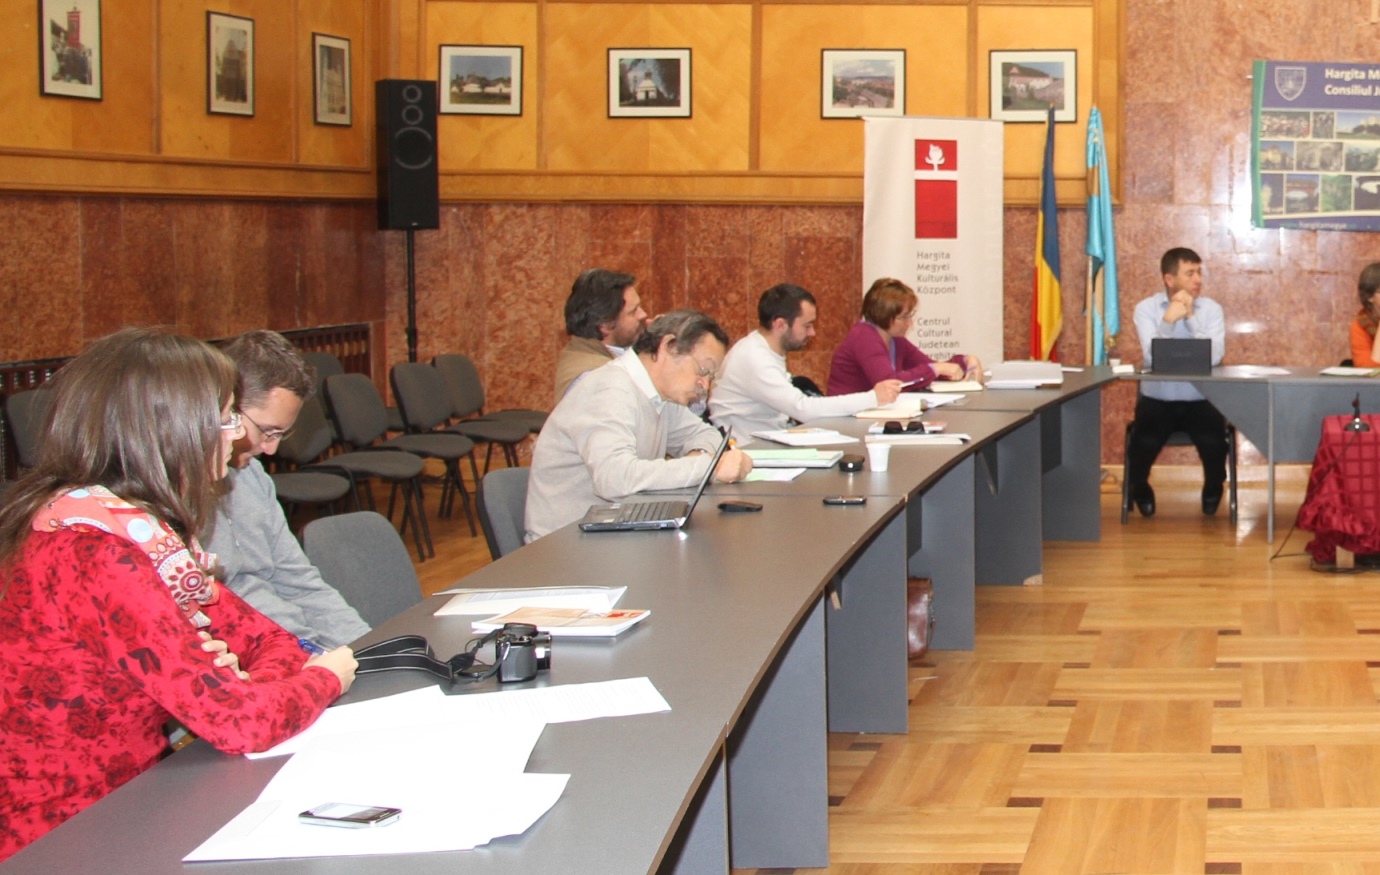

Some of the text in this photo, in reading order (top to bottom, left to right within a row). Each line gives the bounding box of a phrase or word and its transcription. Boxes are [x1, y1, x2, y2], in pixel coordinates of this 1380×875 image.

[1324, 68, 1366, 82] Hargita
[1324, 84, 1373, 97] Consiliul
[916, 251, 951, 261] Hargita
[916, 263, 950, 273] Megyei
[916, 274, 959, 283] Kulturális
[916, 285, 957, 295] Központ
[916, 317, 951, 326] Centrul
[916, 328, 952, 338] Cultural
